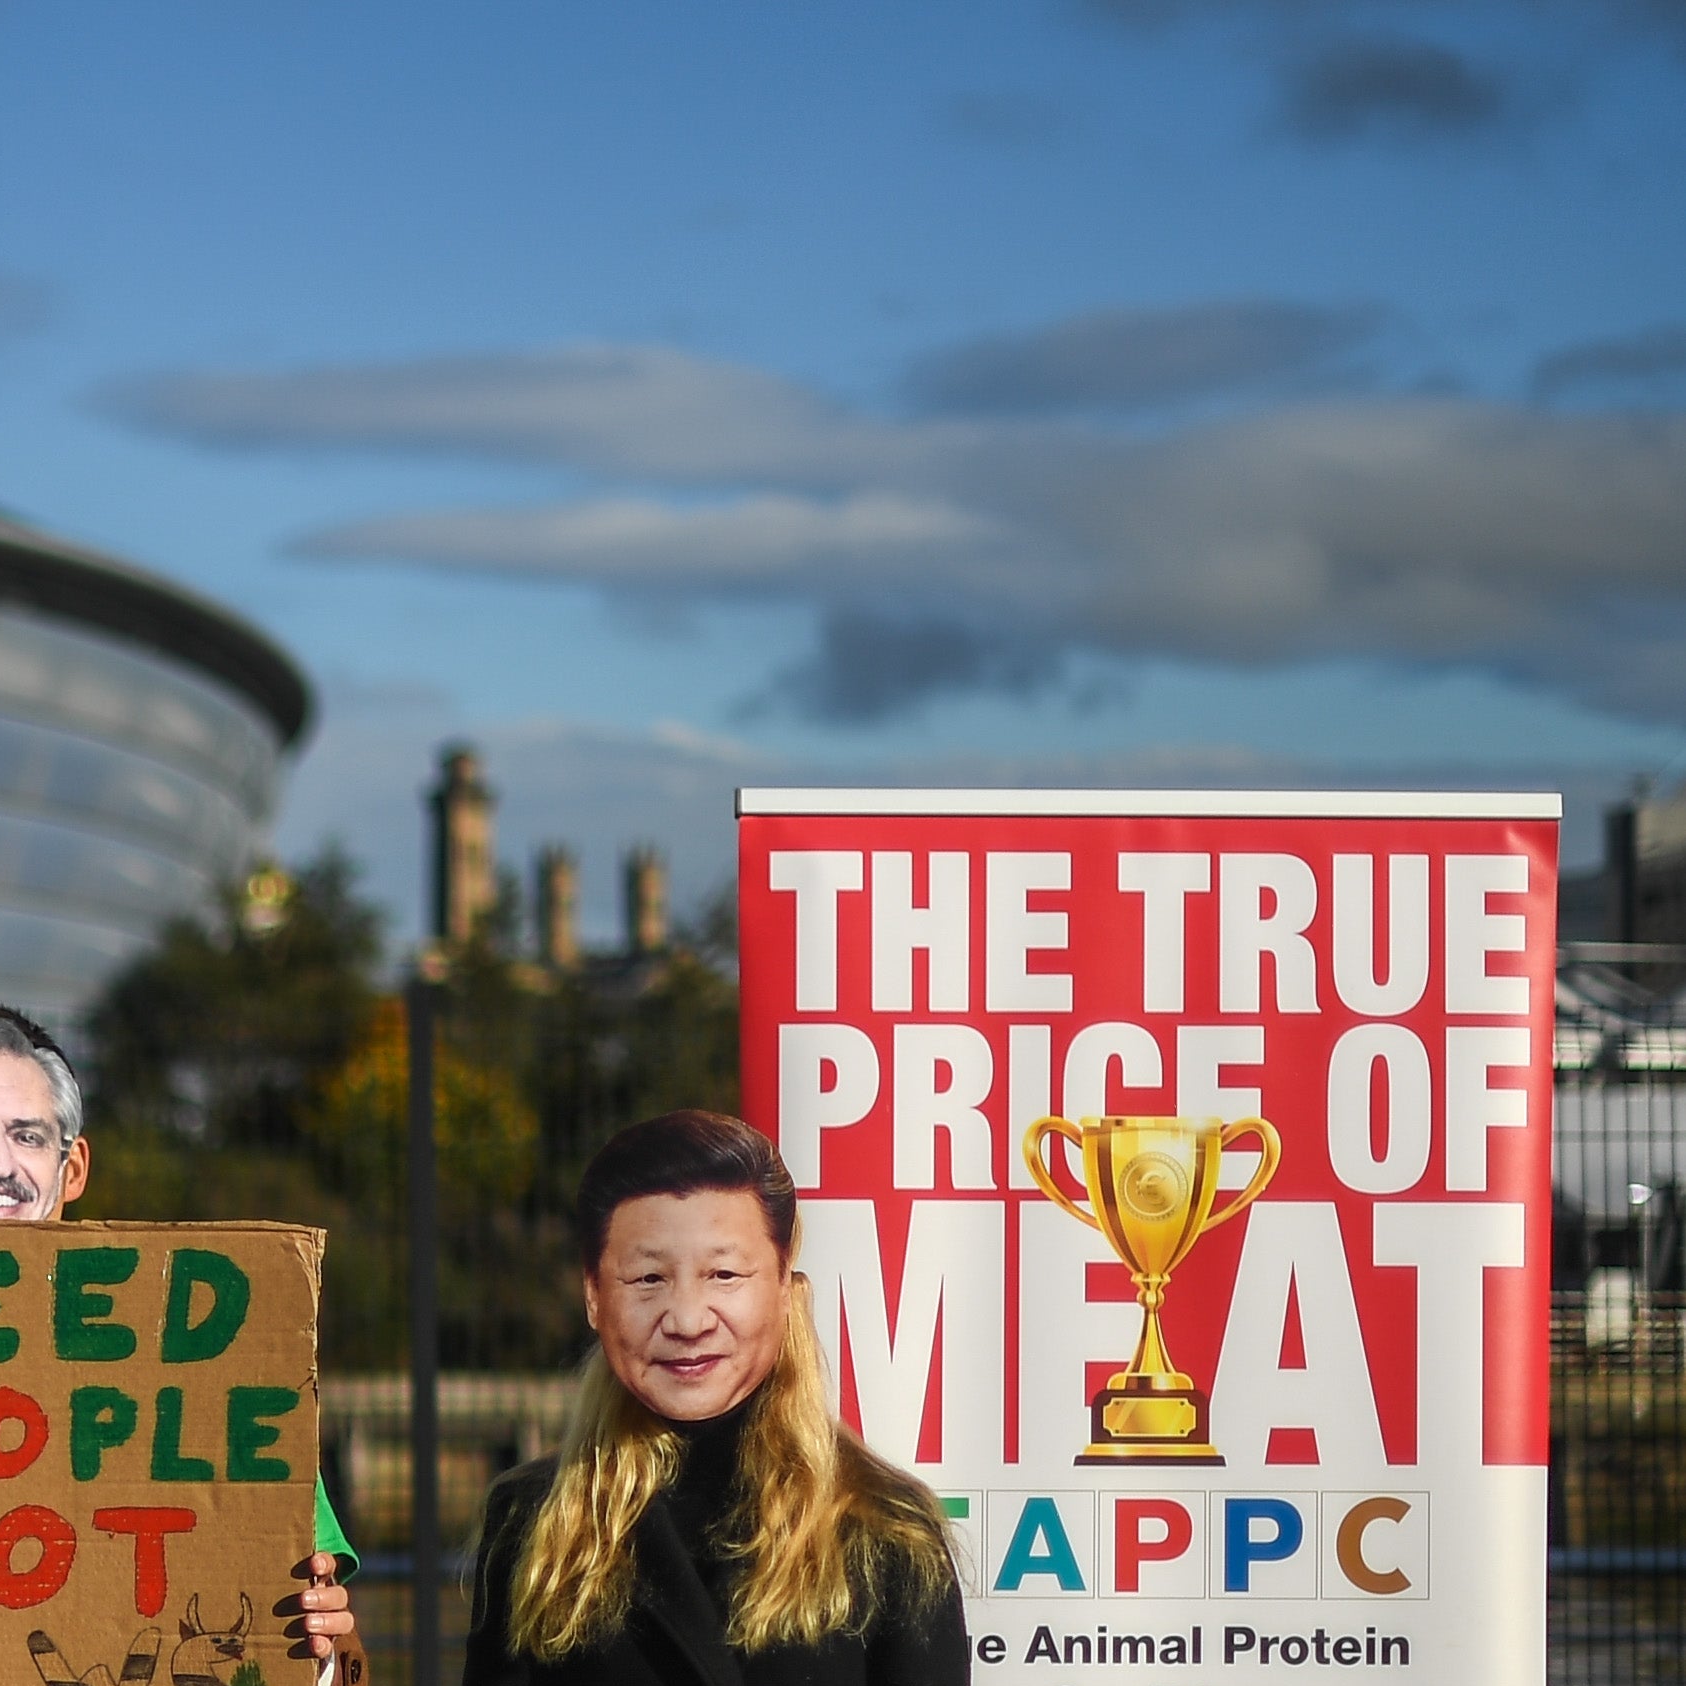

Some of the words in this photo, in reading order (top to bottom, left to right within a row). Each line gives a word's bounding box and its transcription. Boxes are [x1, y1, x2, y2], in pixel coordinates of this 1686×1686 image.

[769, 850, 1075, 1013] THE
[1117, 850, 1531, 1016] TRUE
[777, 1020, 1267, 1192] PRICE
[1326, 1021, 1531, 1195] OF
[796, 1199, 1526, 1468] MEAT
[1024, 1625, 1204, 1666] Animal
[1223, 1625, 1411, 1667] Protein
